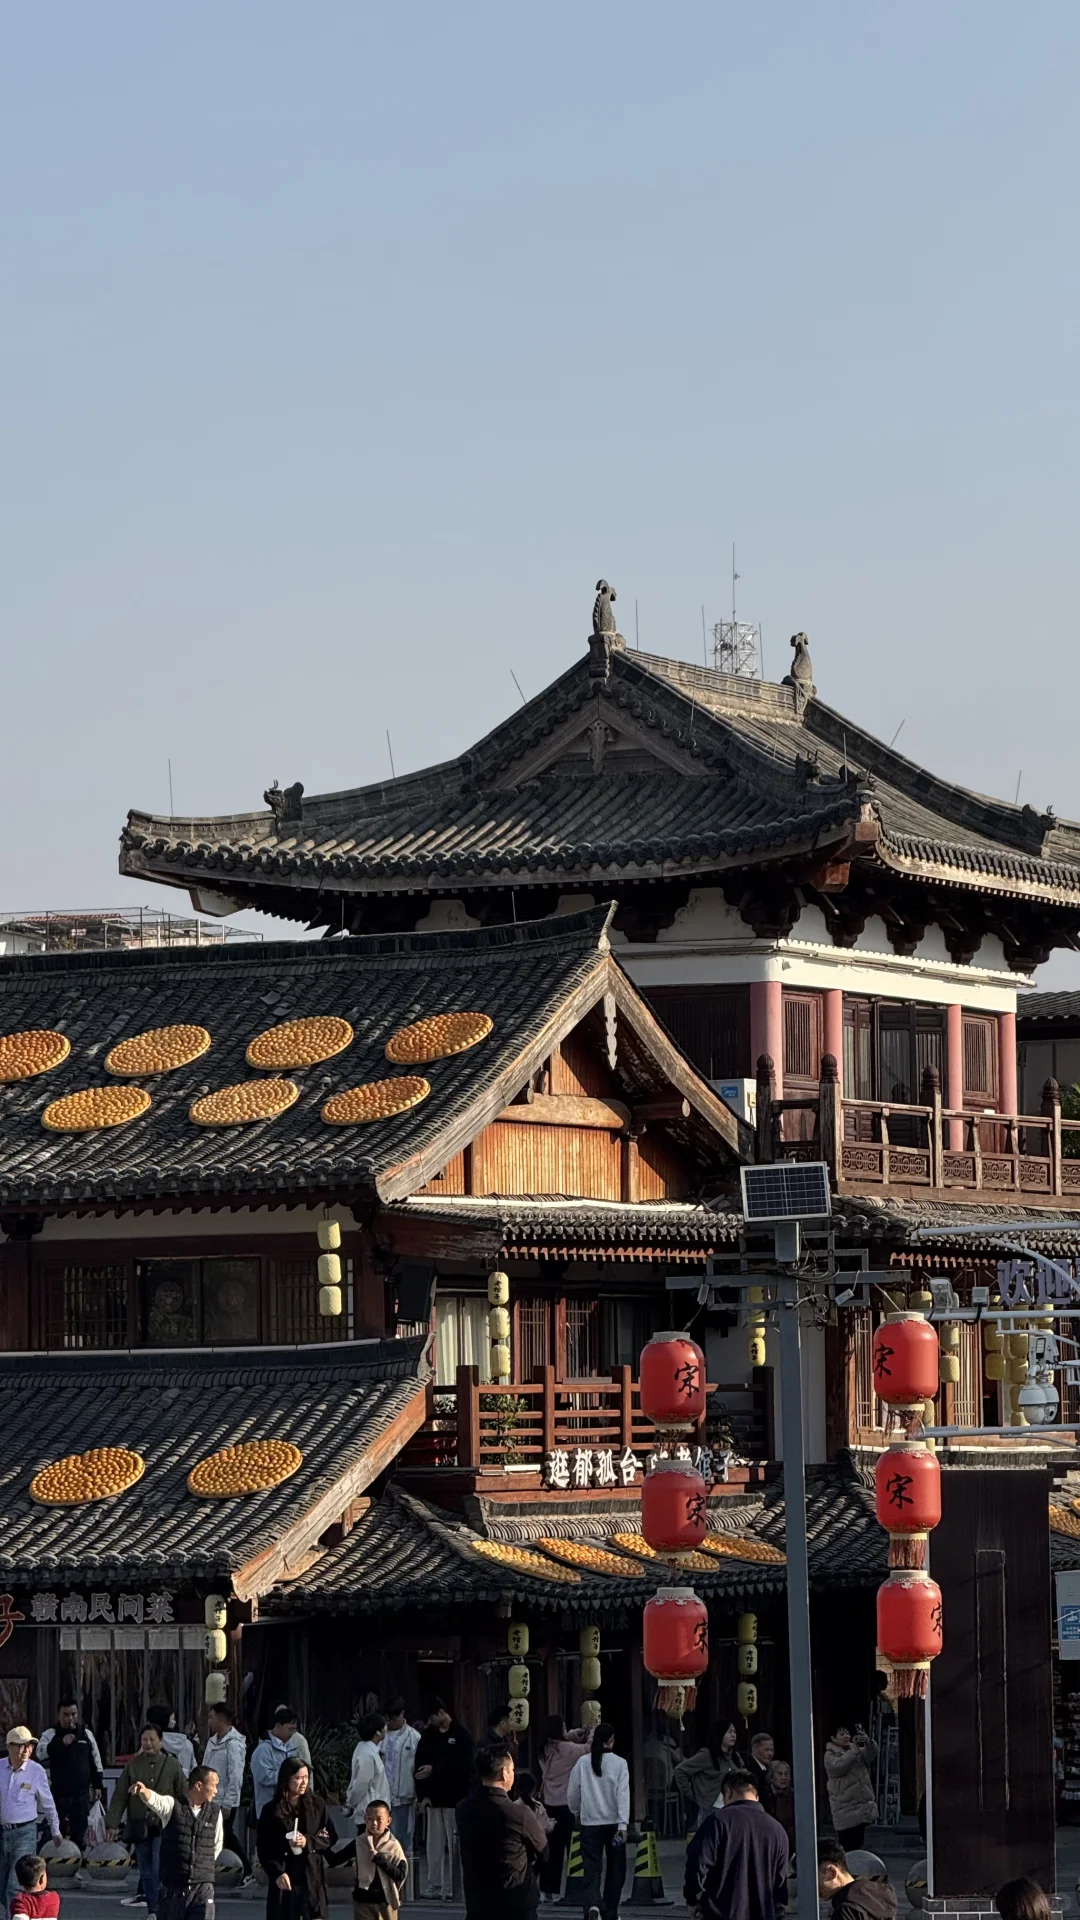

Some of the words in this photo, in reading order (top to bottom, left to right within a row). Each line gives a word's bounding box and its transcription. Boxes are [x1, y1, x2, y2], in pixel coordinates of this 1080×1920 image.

[997, 1258, 1080, 1307] 欢迎
[874, 1342, 895, 1379] 宋
[674, 1361, 700, 1398] 宋
[549, 1446, 637, 1488] 逛郁孤台
[885, 1471, 914, 1510] 宋
[685, 1492, 705, 1528] 宋
[31, 1591, 175, 1624] 赣南民间菜
